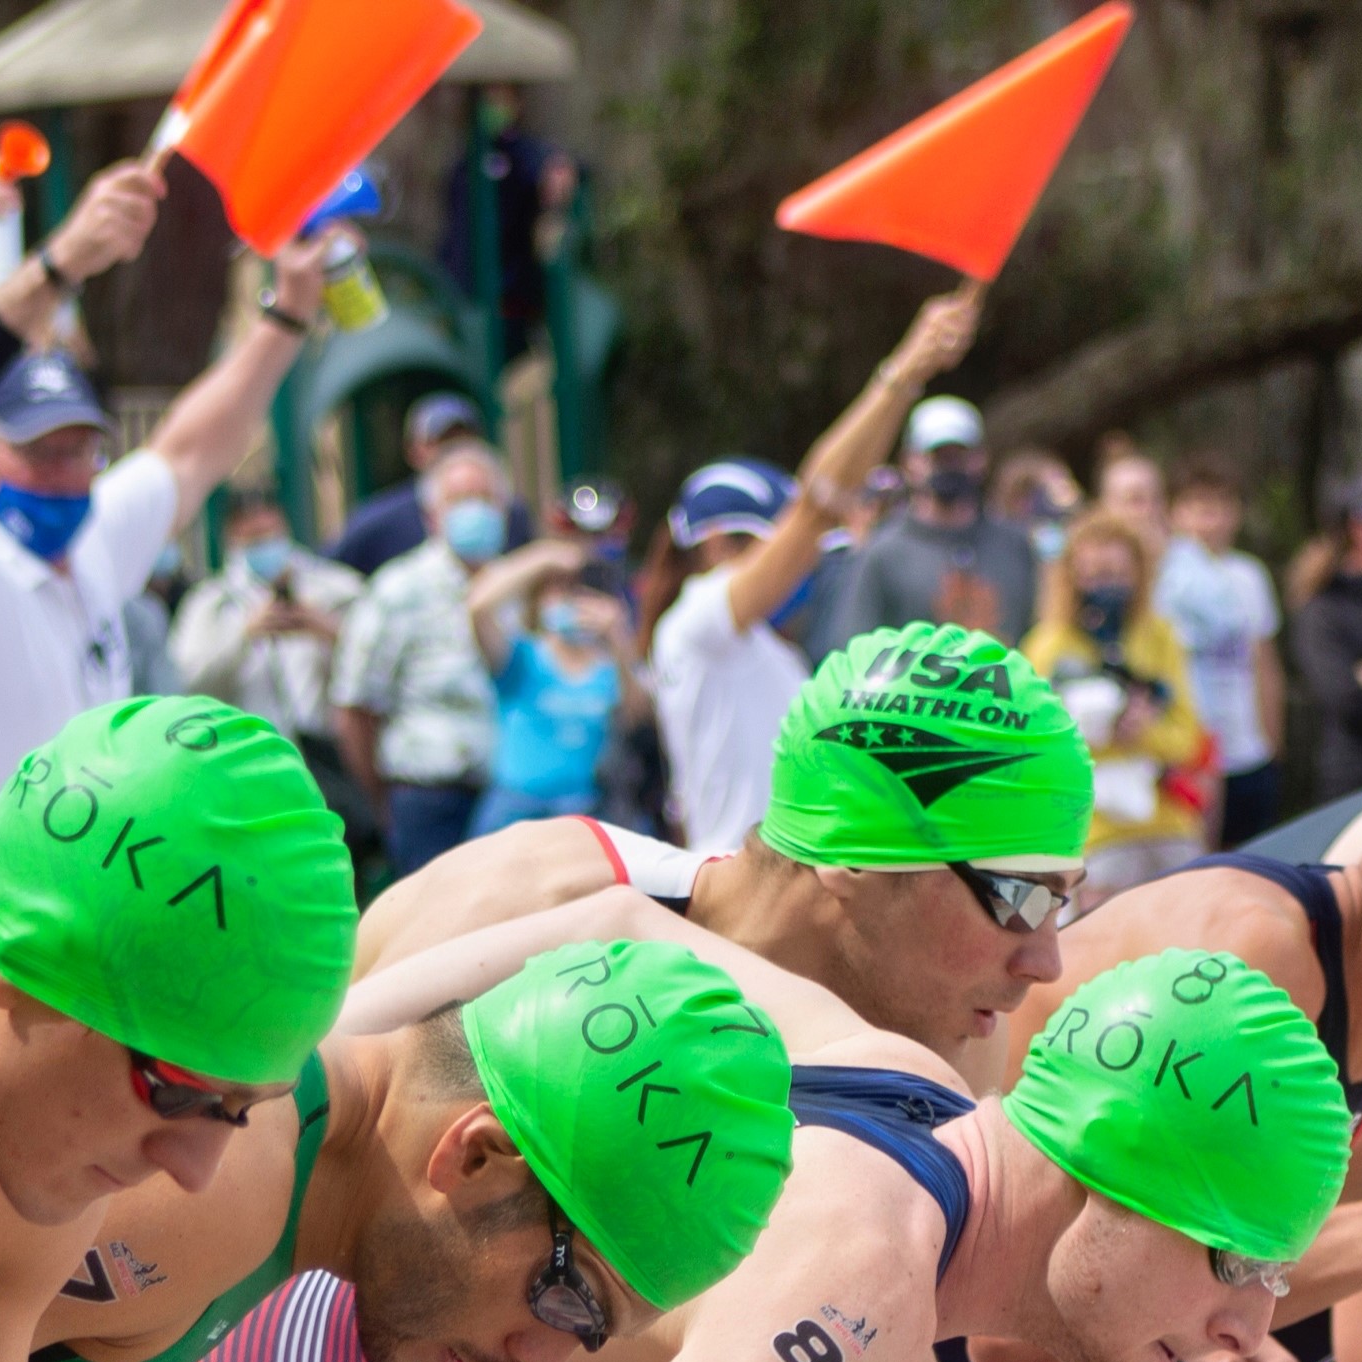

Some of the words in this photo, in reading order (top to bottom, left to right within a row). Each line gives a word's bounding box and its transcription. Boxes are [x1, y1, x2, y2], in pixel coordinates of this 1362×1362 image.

[863, 645, 1015, 704] USA
[838, 689, 1031, 731] TRIATHLON
[1172, 958, 1227, 1005] 8
[555, 1244, 566, 1268] TYR
